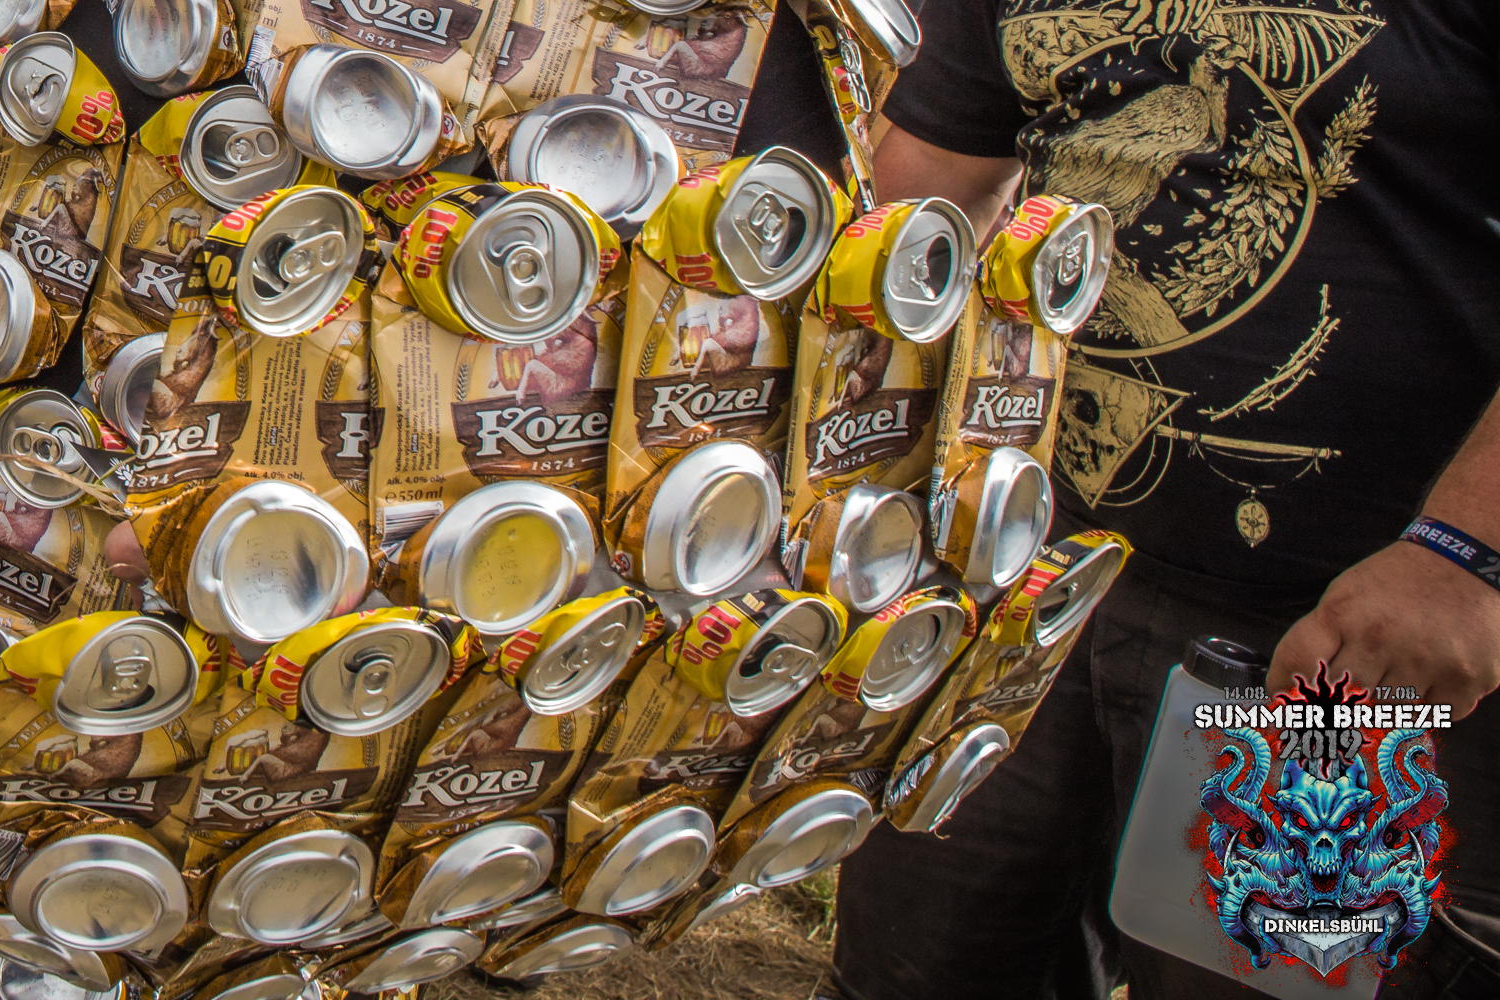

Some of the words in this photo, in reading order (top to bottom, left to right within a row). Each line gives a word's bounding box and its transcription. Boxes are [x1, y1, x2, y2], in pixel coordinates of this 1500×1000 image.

[262, 15, 279, 28] ml
[356, 29, 397, 49] 1874
[71, 90, 115, 142] 10%
[605, 61, 748, 128] Kozel
[11, 223, 99, 286] Kozel
[413, 208, 458, 280] 10%
[646, 377, 776, 429] Kozel
[966, 385, 1045, 429] Kozel
[138, 412, 221, 460] ozel
[475, 406, 609, 457] Koze
[687, 428, 722, 443] 1874
[812, 398, 910, 467] Kozel
[128, 474, 169, 489] 1874
[531, 457, 575, 472] 1874
[836, 450, 866, 469] 1874
[424, 486, 444, 501] ml
[681, 604, 742, 666] 10%
[0, 779, 156, 805] Kozel
[193, 777, 348, 821] Kozel
[402, 760, 545, 807] Kozel
